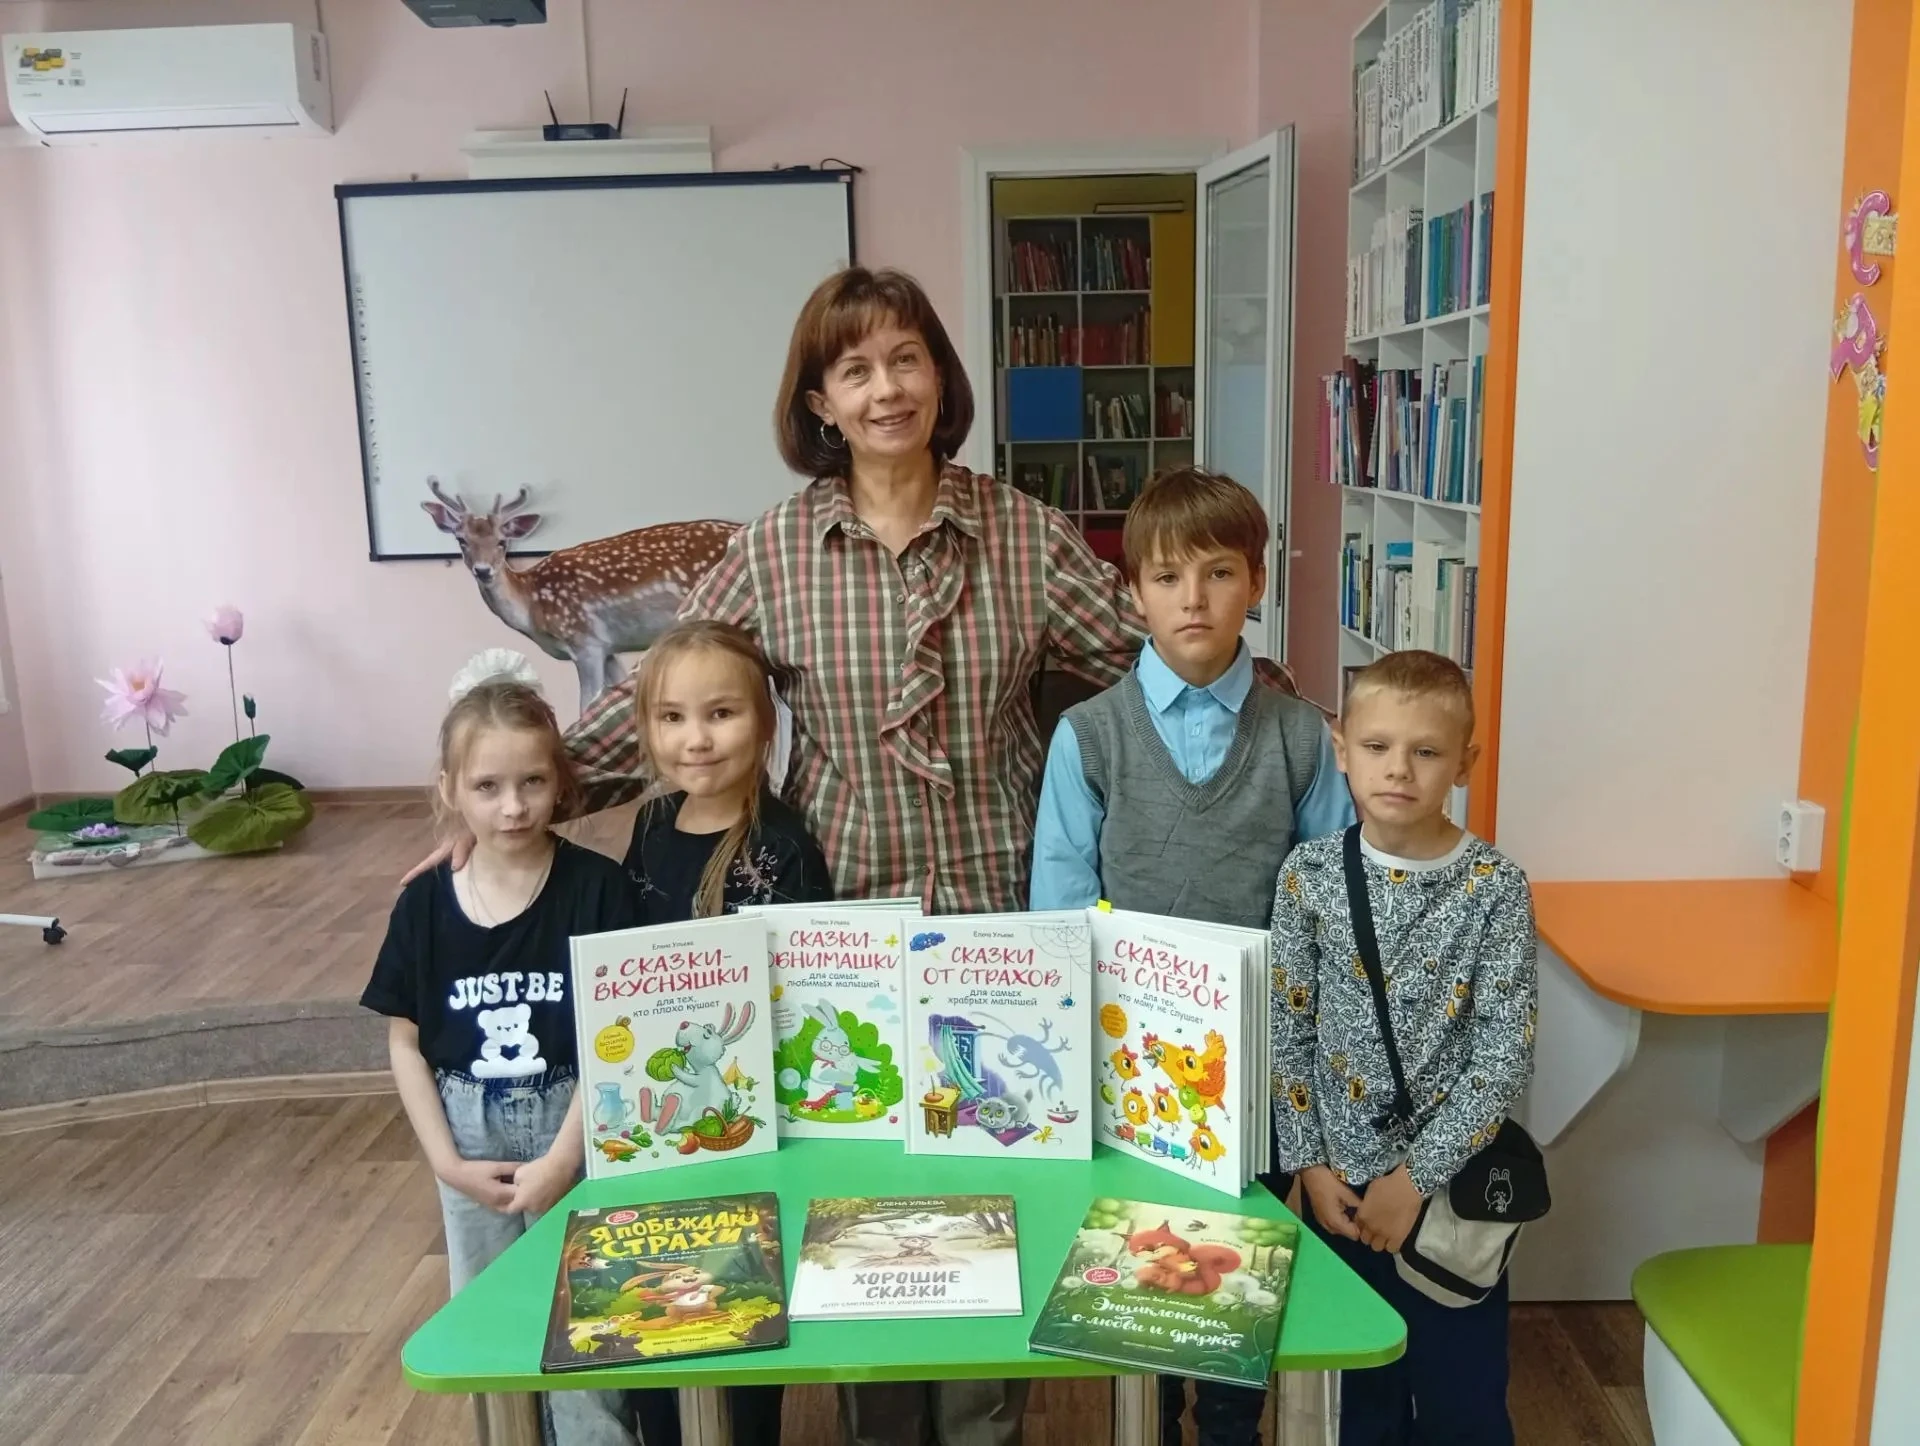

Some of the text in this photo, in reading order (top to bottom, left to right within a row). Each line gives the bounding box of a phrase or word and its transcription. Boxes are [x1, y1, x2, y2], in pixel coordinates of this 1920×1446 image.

[790, 930, 878, 948] СКАЗКИ-
[620, 949, 732, 977] СКАЗКИ-
[951, 946, 1034, 965] СКАЗКИ
[1115, 939, 1208, 984] СКАЗКИ
[594, 965, 748, 1001] ВКУСНЯШКИ
[787, 979, 880, 988] любимых малышей
[923, 967, 1062, 987] ОТ СТРАХОВ
[1135, 967, 1229, 1011] СЛЁЗОК
[449, 971, 564, 1010] JUST BE
[656, 997, 675, 1007] для
[948, 996, 1038, 1006] храбрых малышей
[1143, 993, 1158, 1002] для
[633, 1000, 720, 1017] кто плохо кушает
[1118, 993, 1131, 1001] кто
[1134, 998, 1153, 1011] маму
[1170, 1009, 1203, 1024] слушает
[590, 1226, 612, 1244] Я
[616, 1208, 760, 1240] ПОБЕЖДАЮ
[601, 1228, 742, 1258] СТРАХИ
[852, 1271, 961, 1285] ХОРОШИЕ
[866, 1284, 946, 1299] СКАЗКИ
[1091, 1296, 1231, 1330] Энциклопедия
[1087, 1314, 1146, 1333] любви
[1150, 1324, 1165, 1335] и
[1169, 1328, 1244, 1348] дружбе
